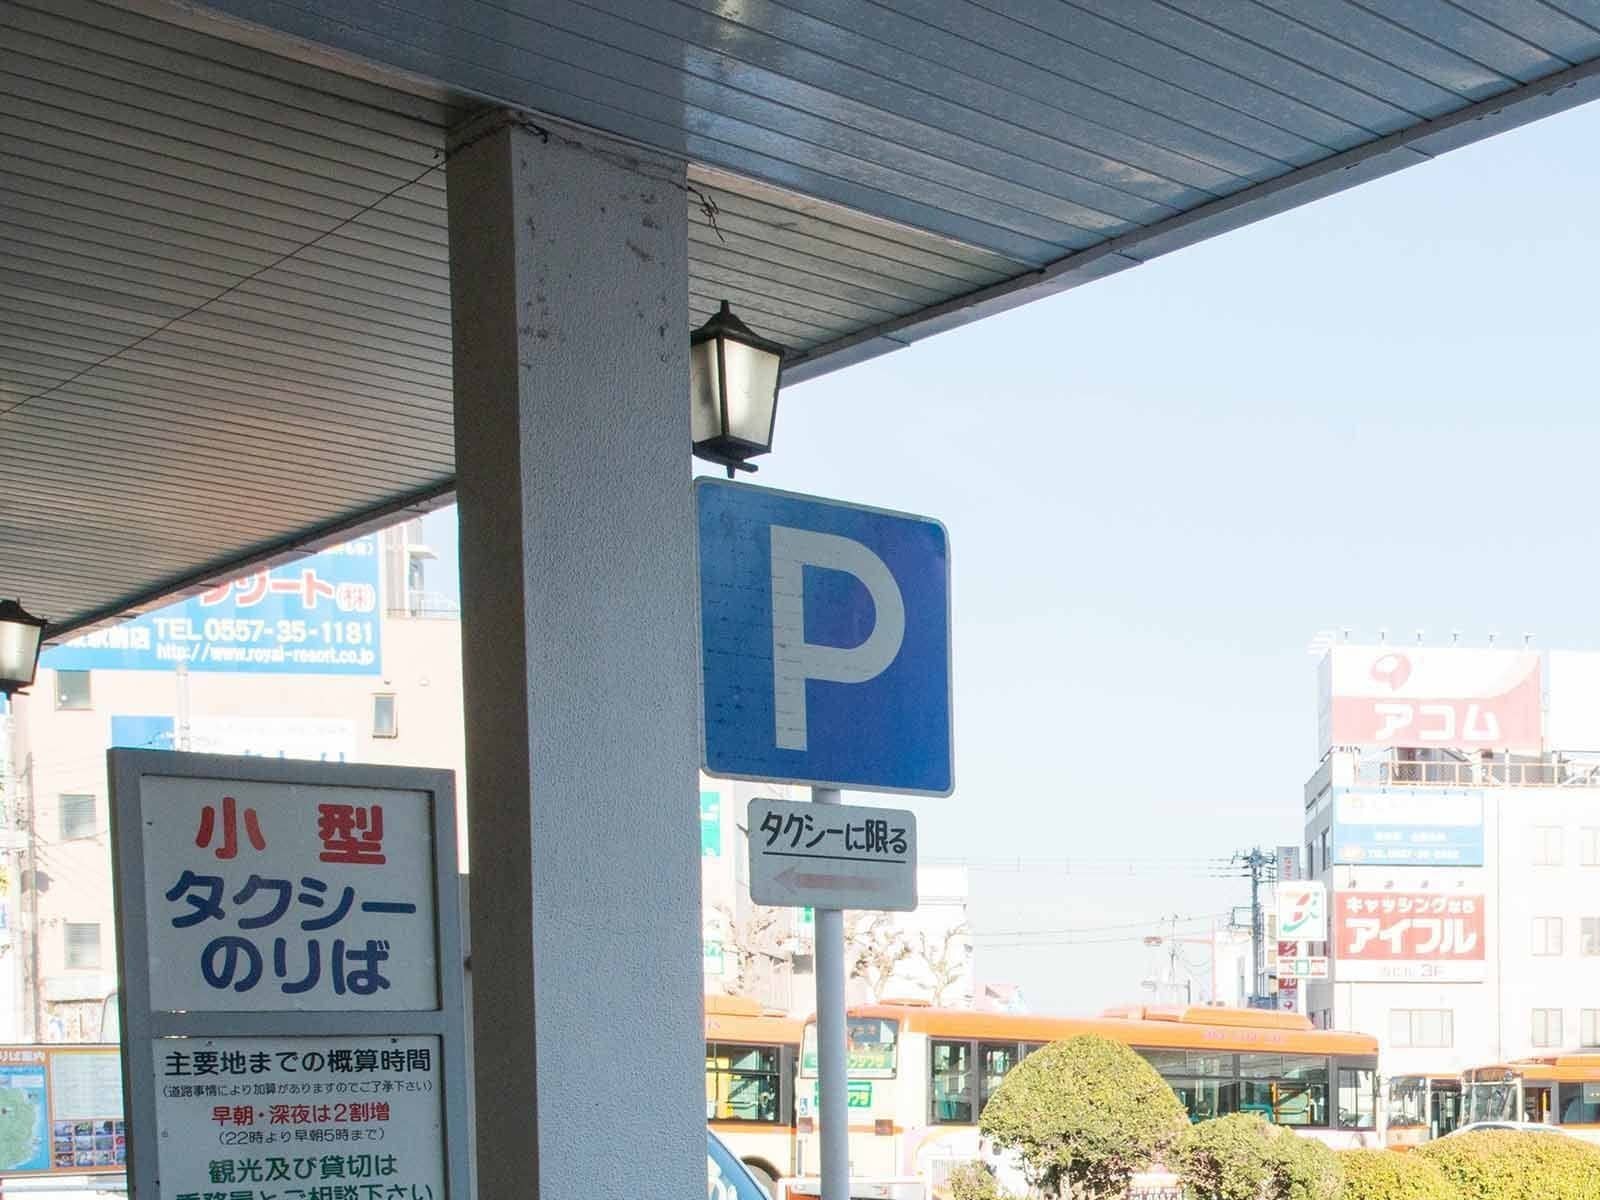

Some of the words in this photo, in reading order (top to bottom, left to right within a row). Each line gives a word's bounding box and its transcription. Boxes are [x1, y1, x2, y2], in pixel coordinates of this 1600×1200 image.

[153, 617, 202, 641] TEL
[204, 618, 373, 644] 0557-35-1181
[769, 525, 906, 751] P
[157, 643, 375, 666] http://www.royal-resort.co.jp
[1372, 701, 1500, 743] アコム
[760, 811, 908, 855] タクシーに限る
[165, 870, 418, 931] タクシー
[1344, 917, 1479, 955] アイフル
[200, 935, 391, 996] のりば
[164, 1049, 431, 1076] 主要地までの概算時間
[211, 1102, 391, 1126] 早朝・深夜は2割増
[218, 1128, 385, 1146] （22時より早朝5時まで）
[208, 1153, 399, 1184] 観光及び貸切は
